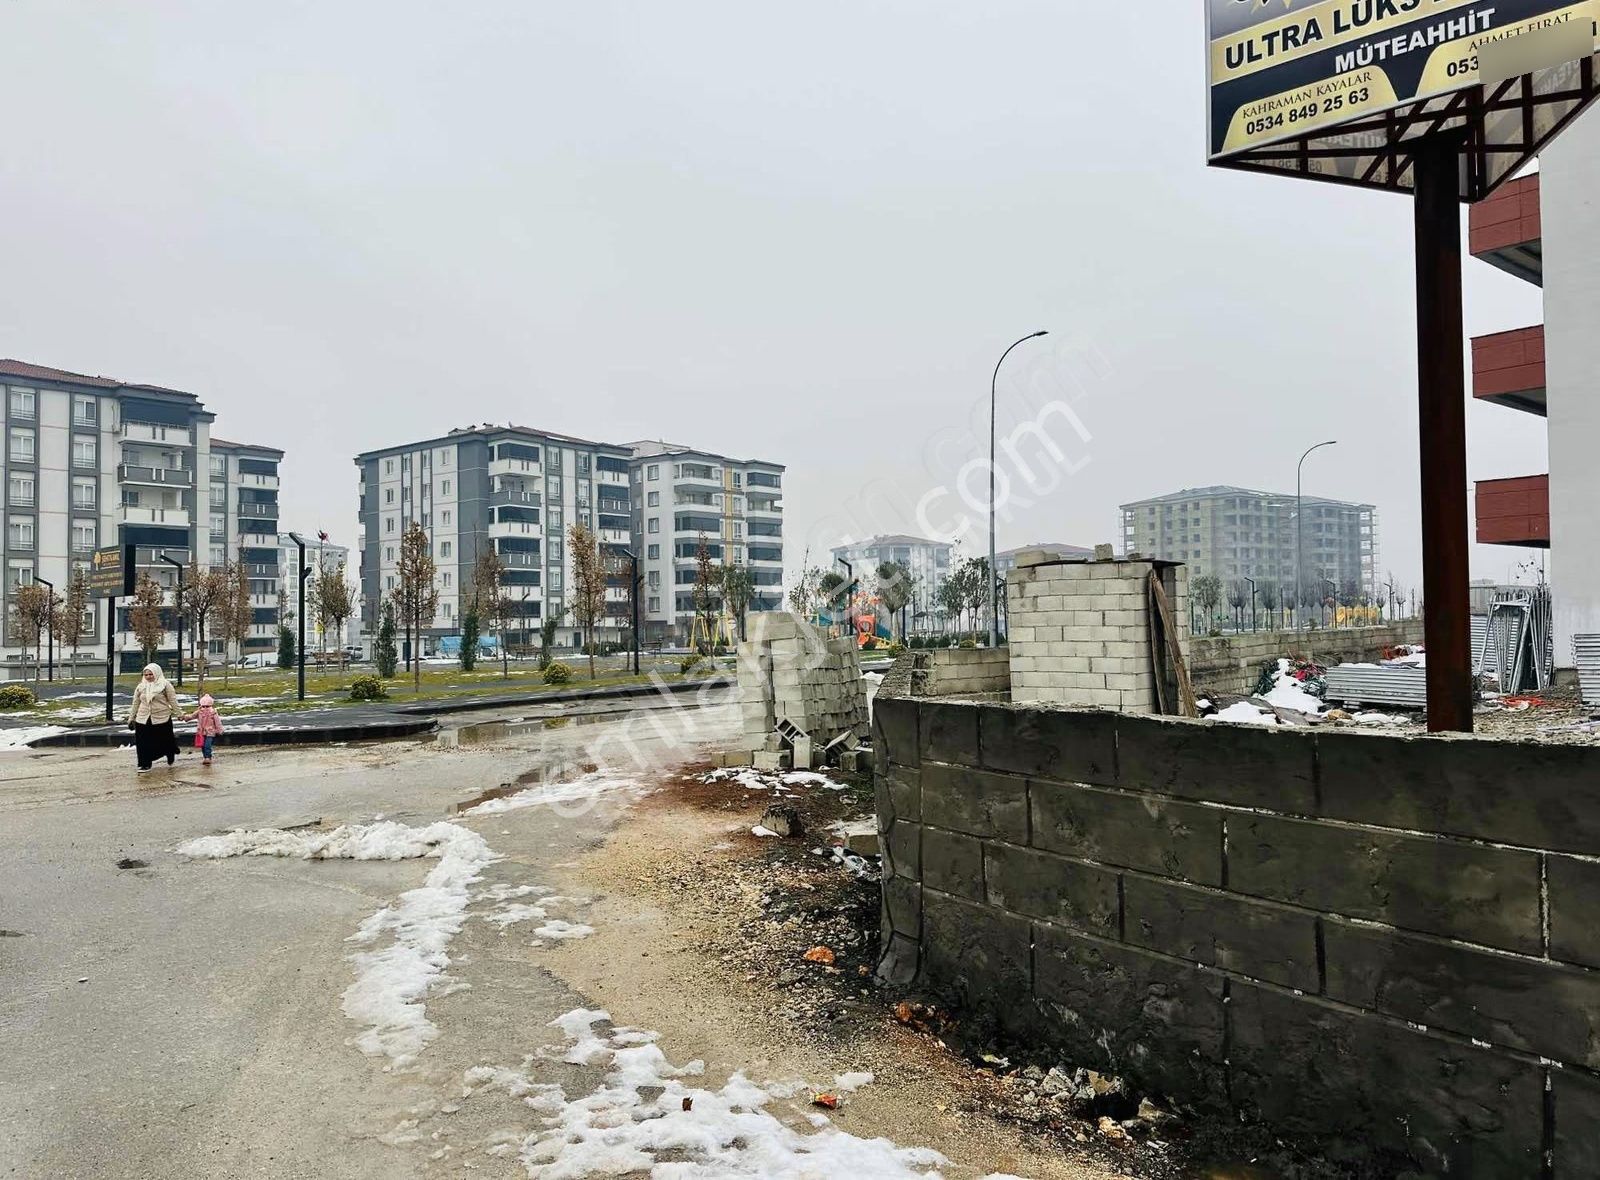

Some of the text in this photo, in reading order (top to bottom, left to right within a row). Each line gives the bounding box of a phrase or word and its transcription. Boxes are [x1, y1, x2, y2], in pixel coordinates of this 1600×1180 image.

[1225, 17, 1323, 70] ULTRA
[1335, 8, 1496, 74] MÜTEAHHİT
[1242, 71, 1373, 119] KAHRAMAN KAYALAR
[1246, 87, 1370, 135] 0534 849 25 63
